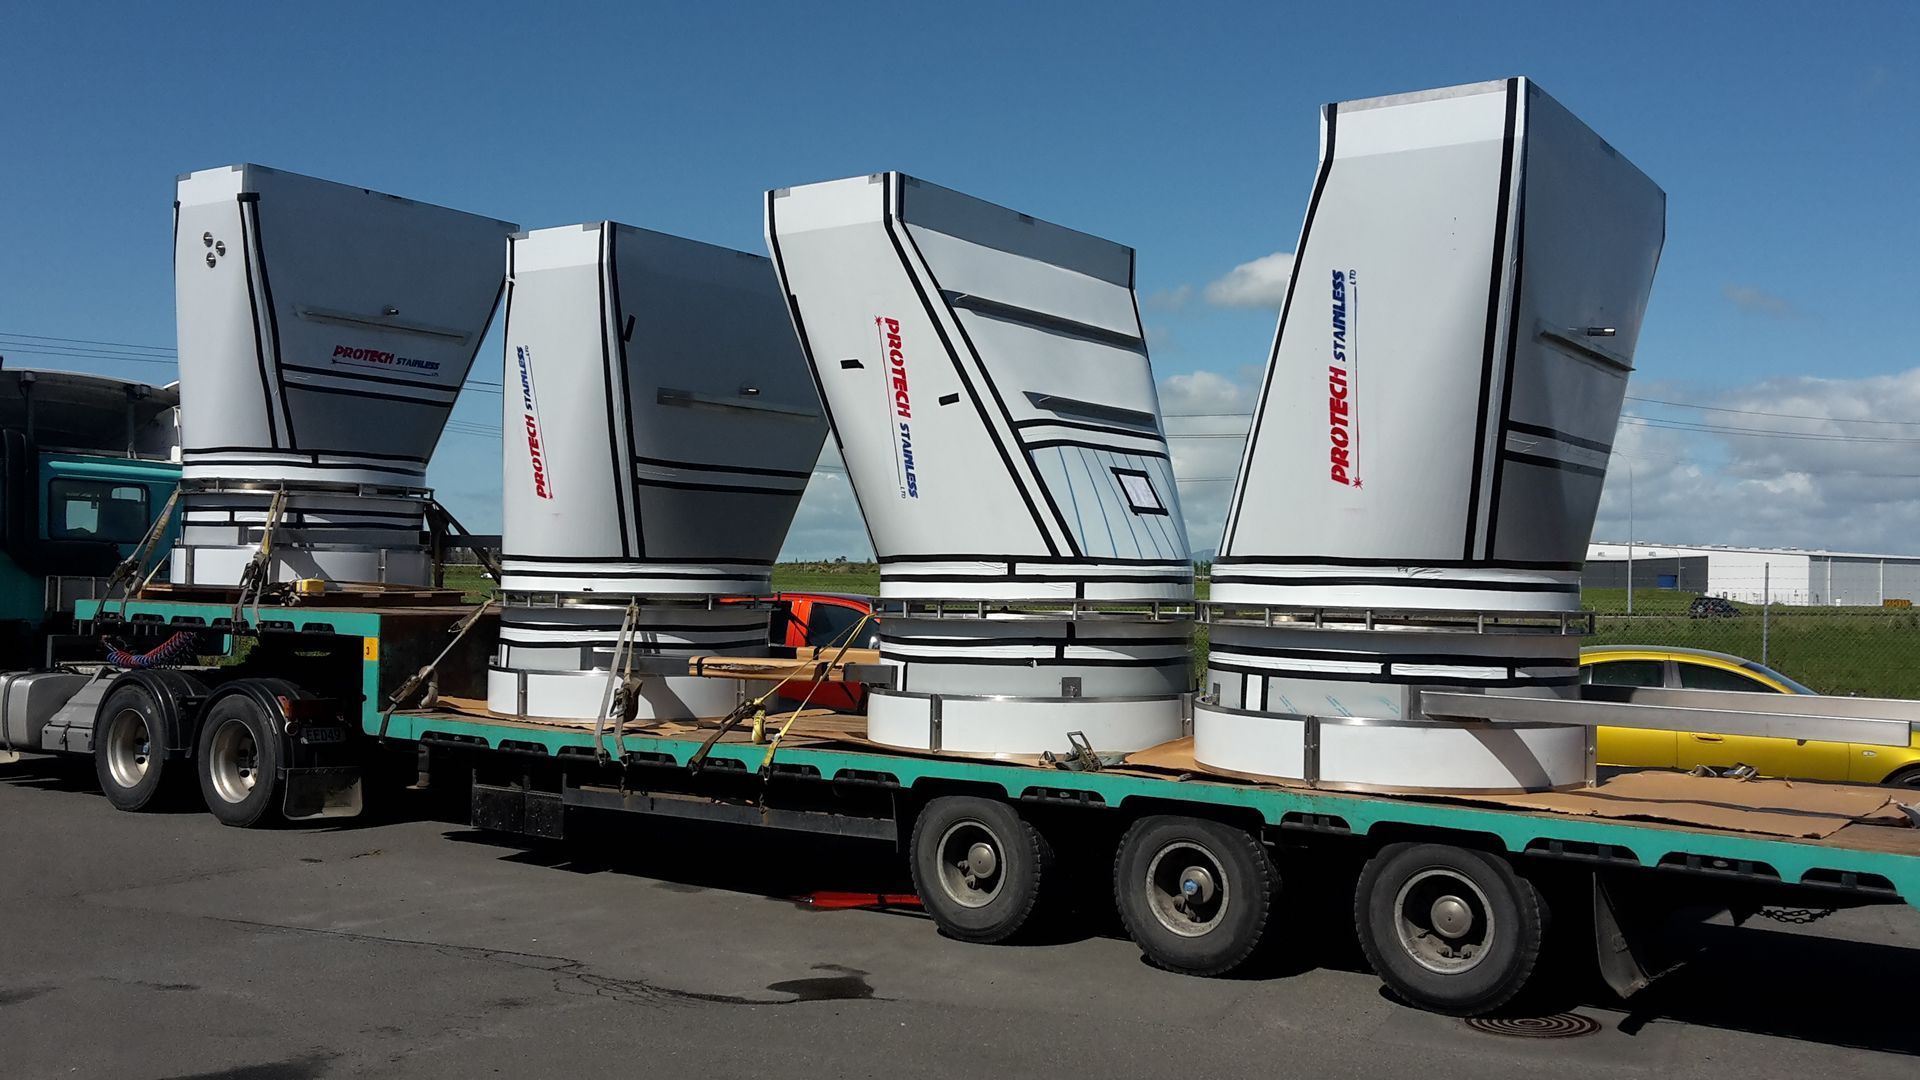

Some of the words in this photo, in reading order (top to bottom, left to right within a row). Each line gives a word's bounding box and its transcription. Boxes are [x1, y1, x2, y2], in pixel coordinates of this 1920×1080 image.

[333, 345, 395, 364] PROTECH
[396, 357, 440, 370] STAINLESS
[1332, 269, 1346, 362] STAINLESS
[517, 346, 533, 411] STAINLESS
[885, 317, 912, 419] PROTECH
[900, 422, 918, 499] STAINLESS
[525, 414, 547, 499] PROTECH
[1329, 366, 1350, 486] PROTECH
